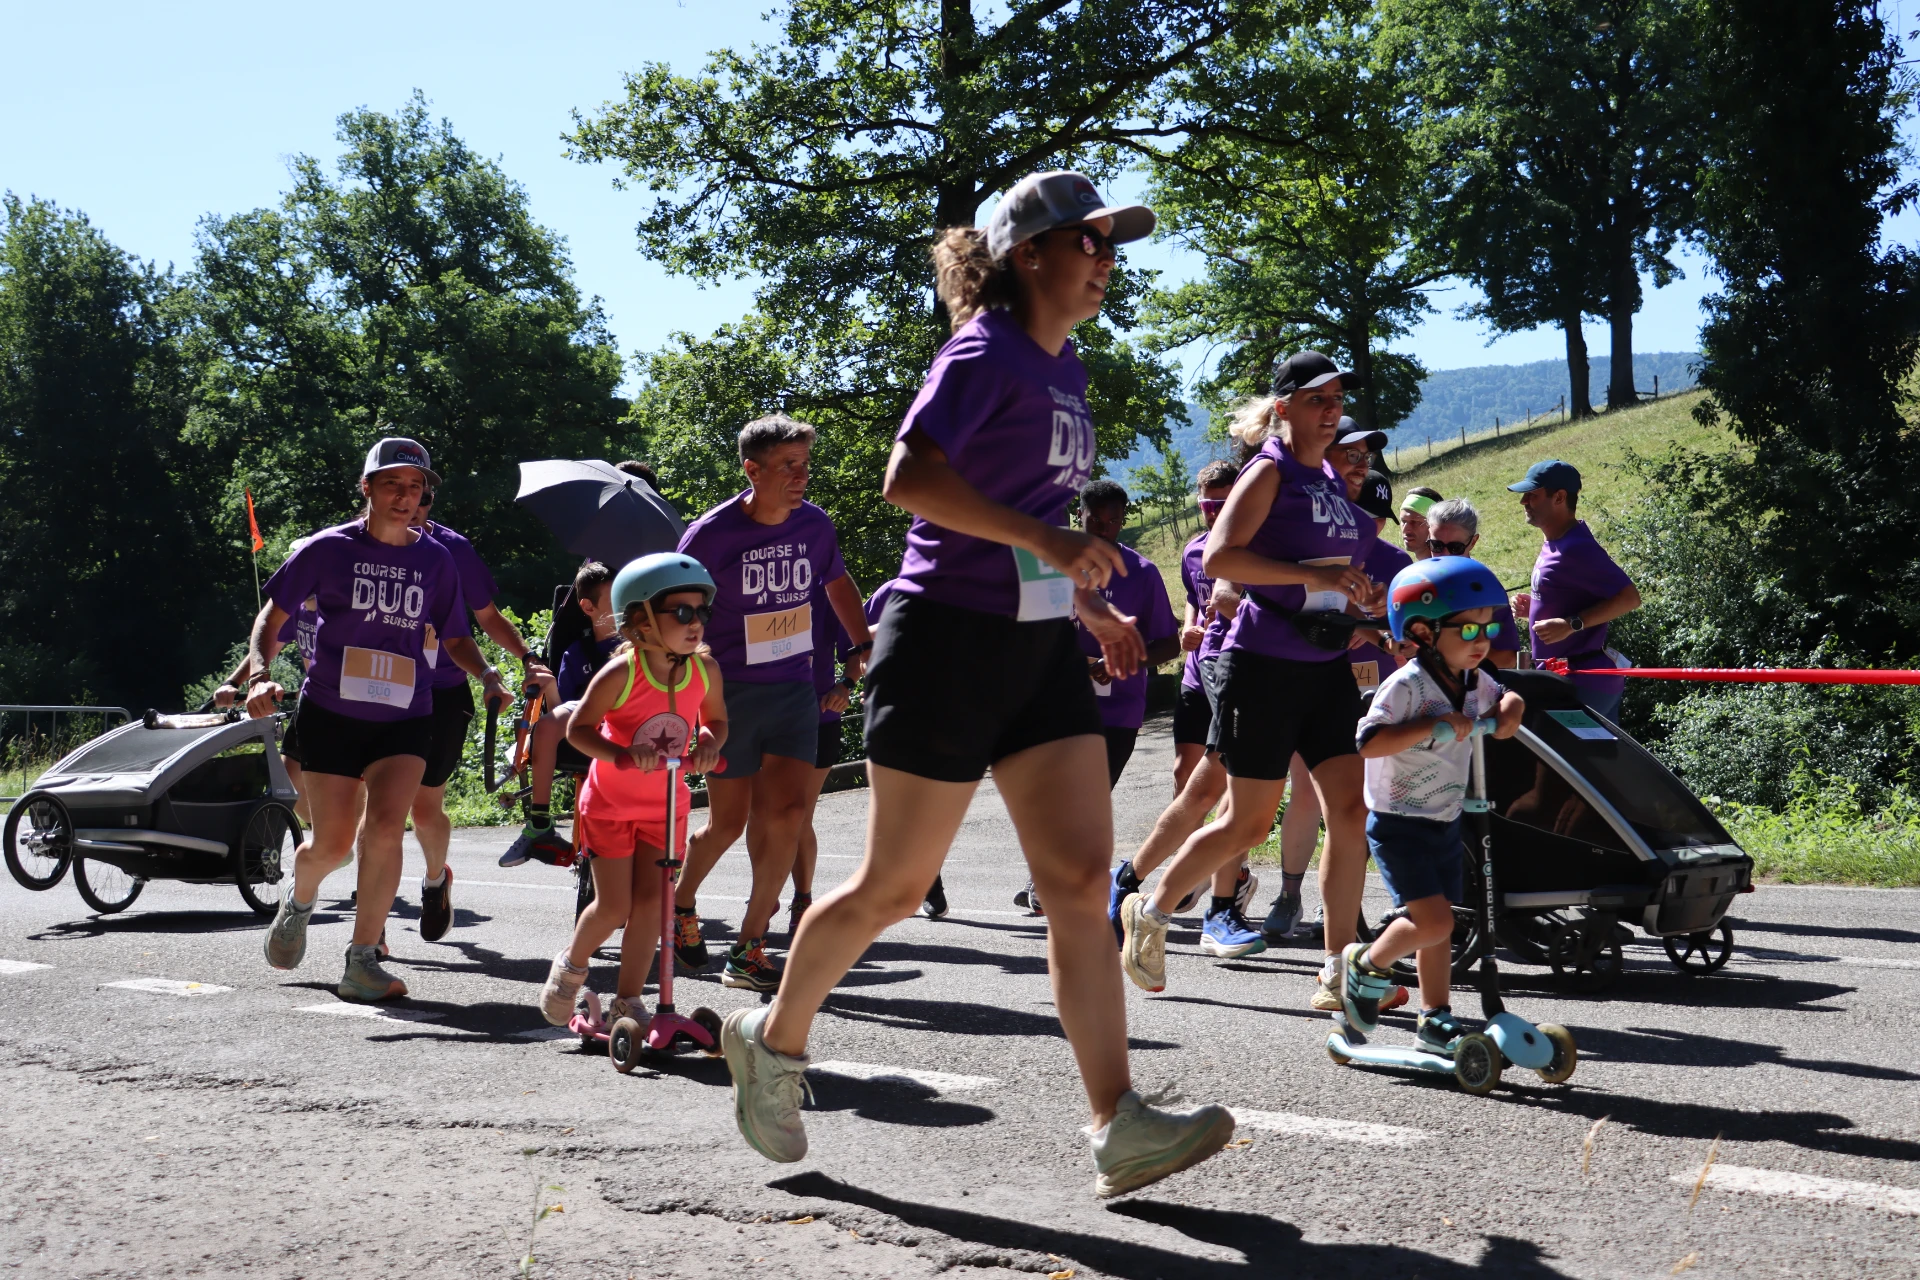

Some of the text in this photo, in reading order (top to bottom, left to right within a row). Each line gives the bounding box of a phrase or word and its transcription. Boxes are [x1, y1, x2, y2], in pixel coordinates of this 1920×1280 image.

[1047, 410, 1095, 471] DU
[1312, 491, 1356, 527] DUO
[742, 544, 793, 563] COURSE
[354, 562, 407, 580] COURSE
[742, 558, 812, 595] DUO
[352, 577, 424, 618] DUO
[775, 590, 810, 604] SUISSE
[382, 614, 419, 630] SUISSE
[766, 612, 797, 637] 111
[771, 641, 792, 655] DUO
[370, 653, 393, 680] 111
[367, 684, 391, 698] DUO
[643, 719, 684, 736] CONVERSE
[1481, 834, 1496, 934] GLOBBER
